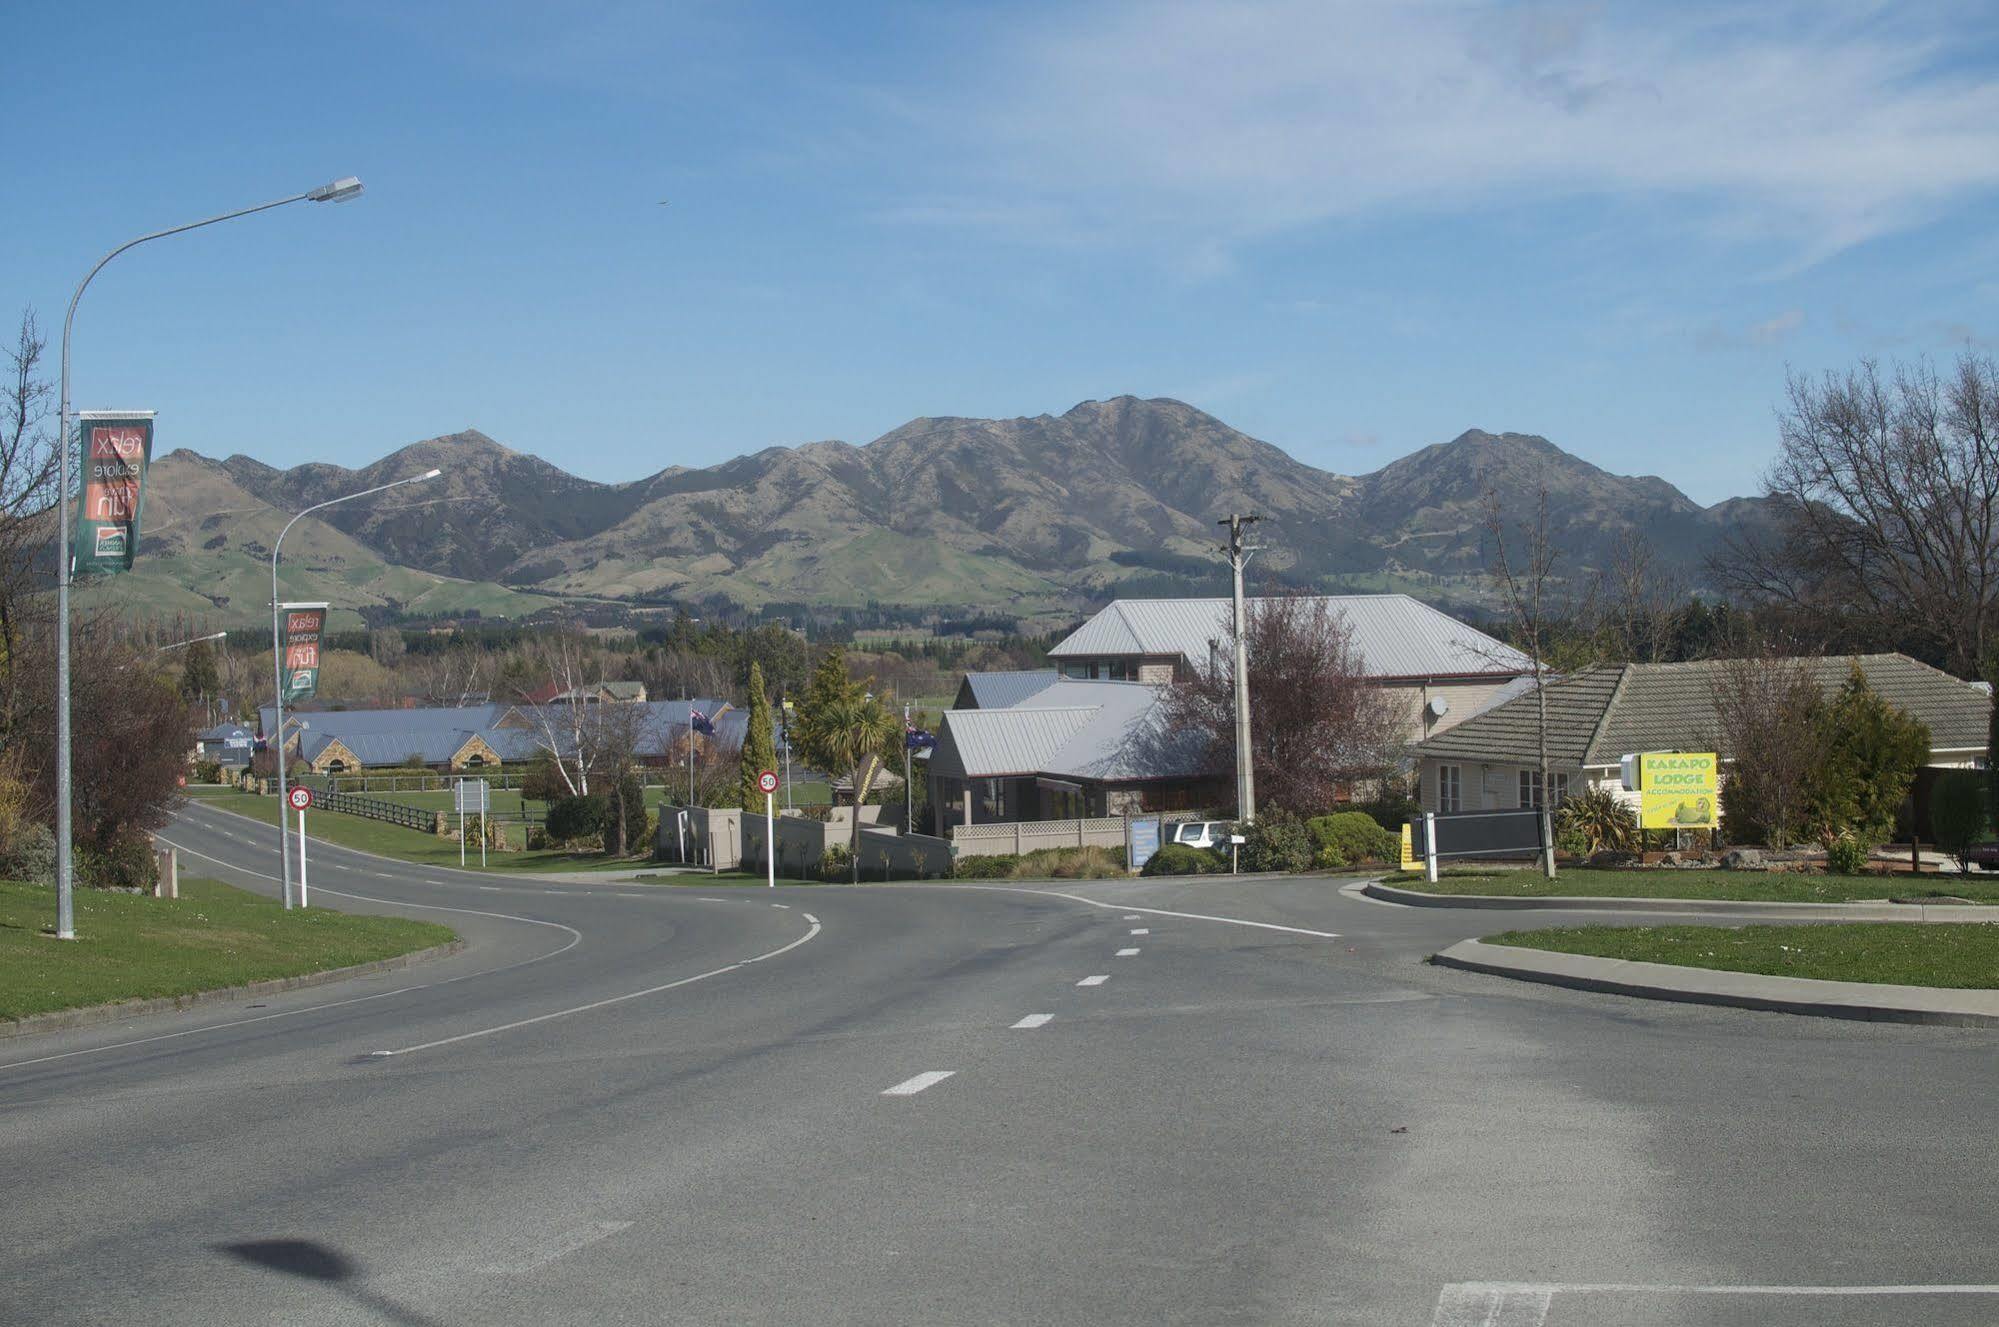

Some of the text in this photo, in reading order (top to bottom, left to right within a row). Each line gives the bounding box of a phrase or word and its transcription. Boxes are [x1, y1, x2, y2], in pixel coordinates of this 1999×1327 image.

[1647, 759, 1711, 770] KAKAPO
[763, 777, 774, 787] 50
[1654, 774, 1704, 785] LODGE
[294, 793, 307, 803] 50
